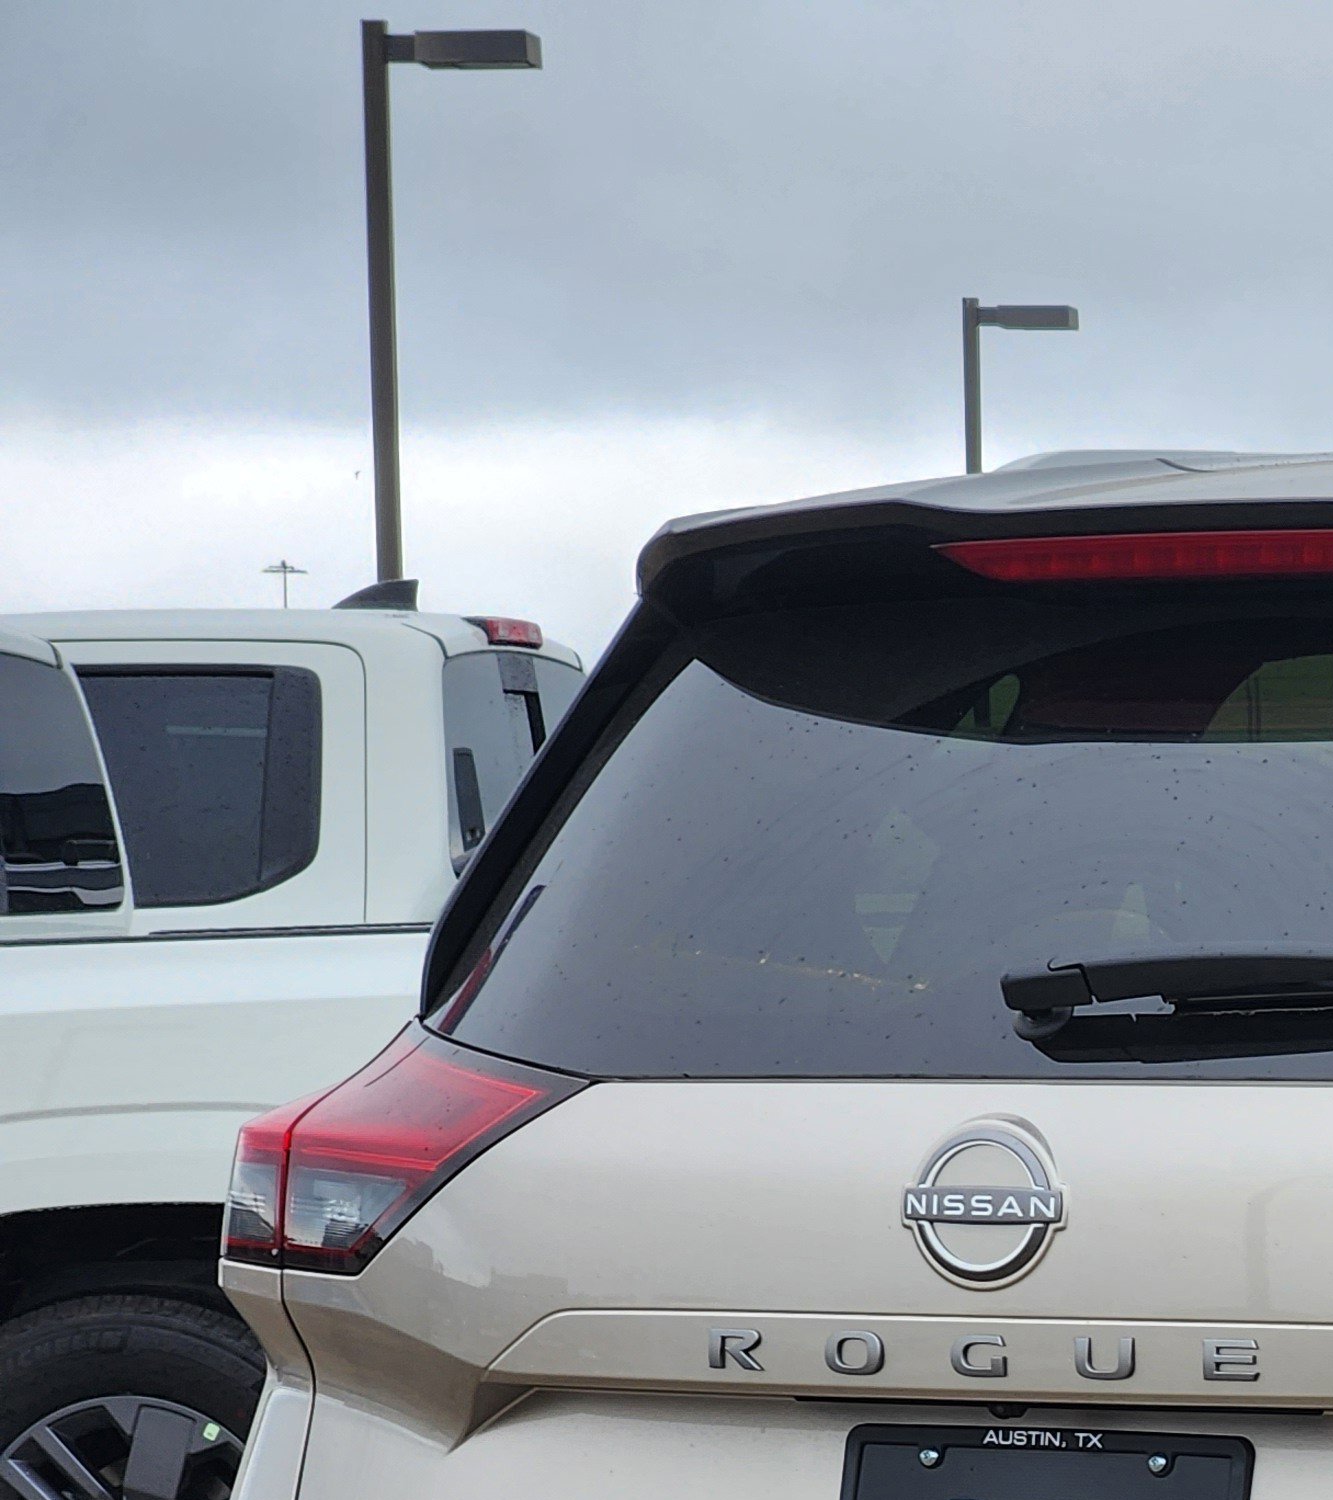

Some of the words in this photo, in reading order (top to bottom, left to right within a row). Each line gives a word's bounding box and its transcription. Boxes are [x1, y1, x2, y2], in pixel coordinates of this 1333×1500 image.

[905, 1192, 1057, 1219] NISSAN
[706, 1327, 1261, 1382] ROGUE
[982, 1429, 1067, 1449] AUSTIN,
[1074, 1432, 1104, 1450] TX
